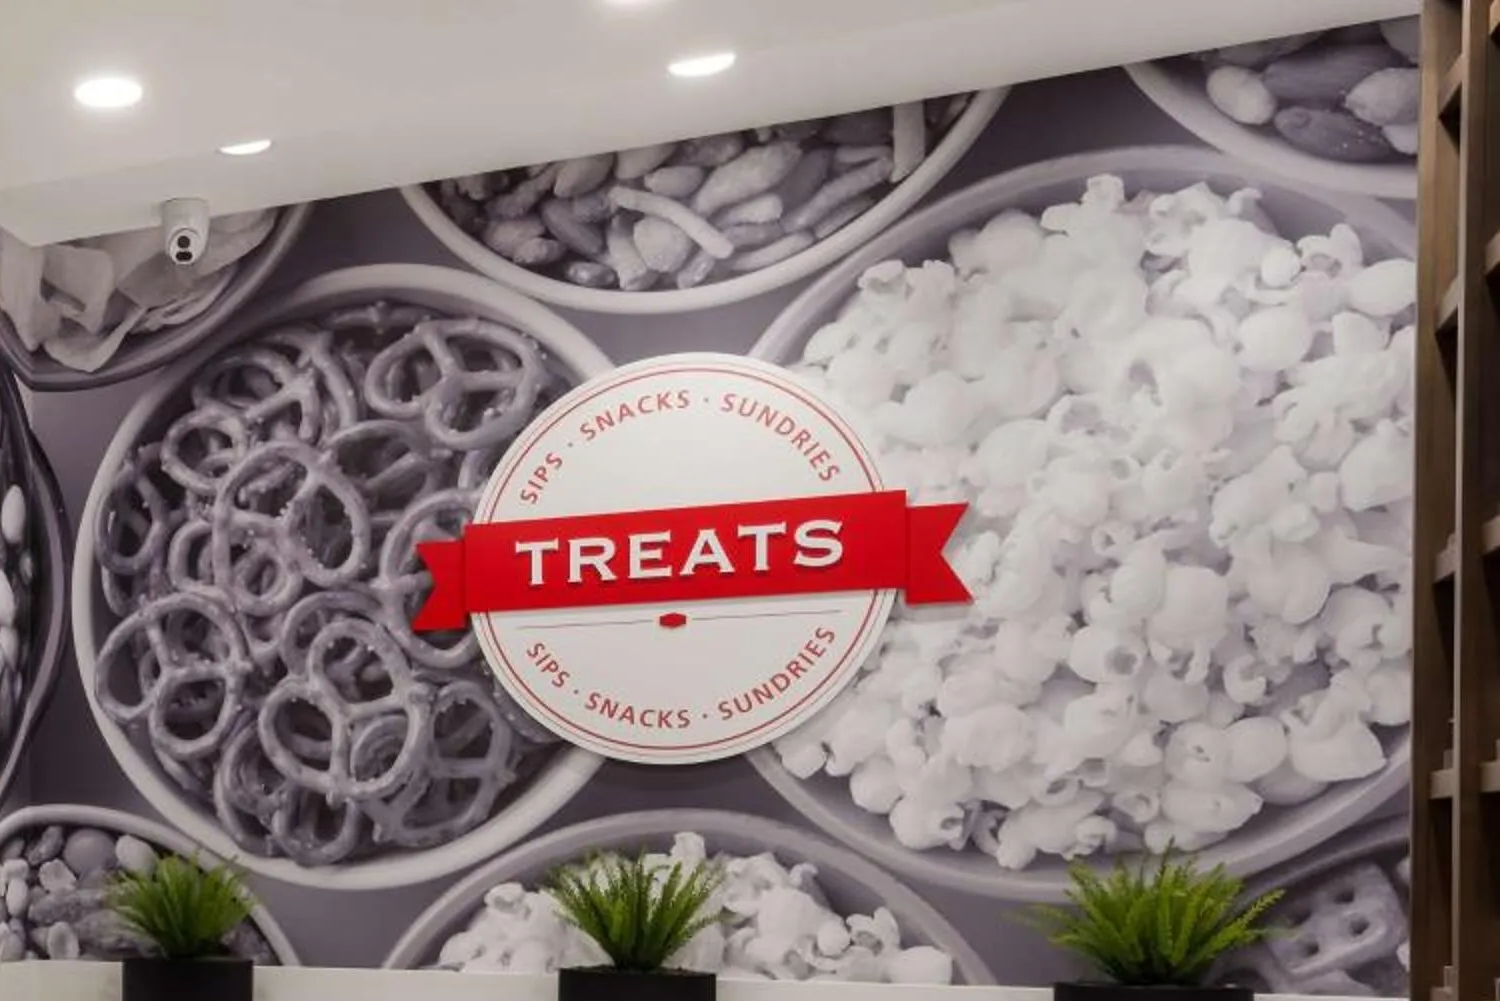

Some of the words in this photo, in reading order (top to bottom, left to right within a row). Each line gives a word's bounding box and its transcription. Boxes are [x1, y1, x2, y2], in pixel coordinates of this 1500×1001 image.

[520, 452, 563, 504] SIPS
[580, 390, 690, 440] SNACKS
[720, 393, 840, 483] SUNDRIES
[515, 519, 843, 586] TREATS
[526, 642, 569, 689] SIPS
[585, 691, 690, 729] SNACKS
[718, 626, 836, 720] SUNDRIES
